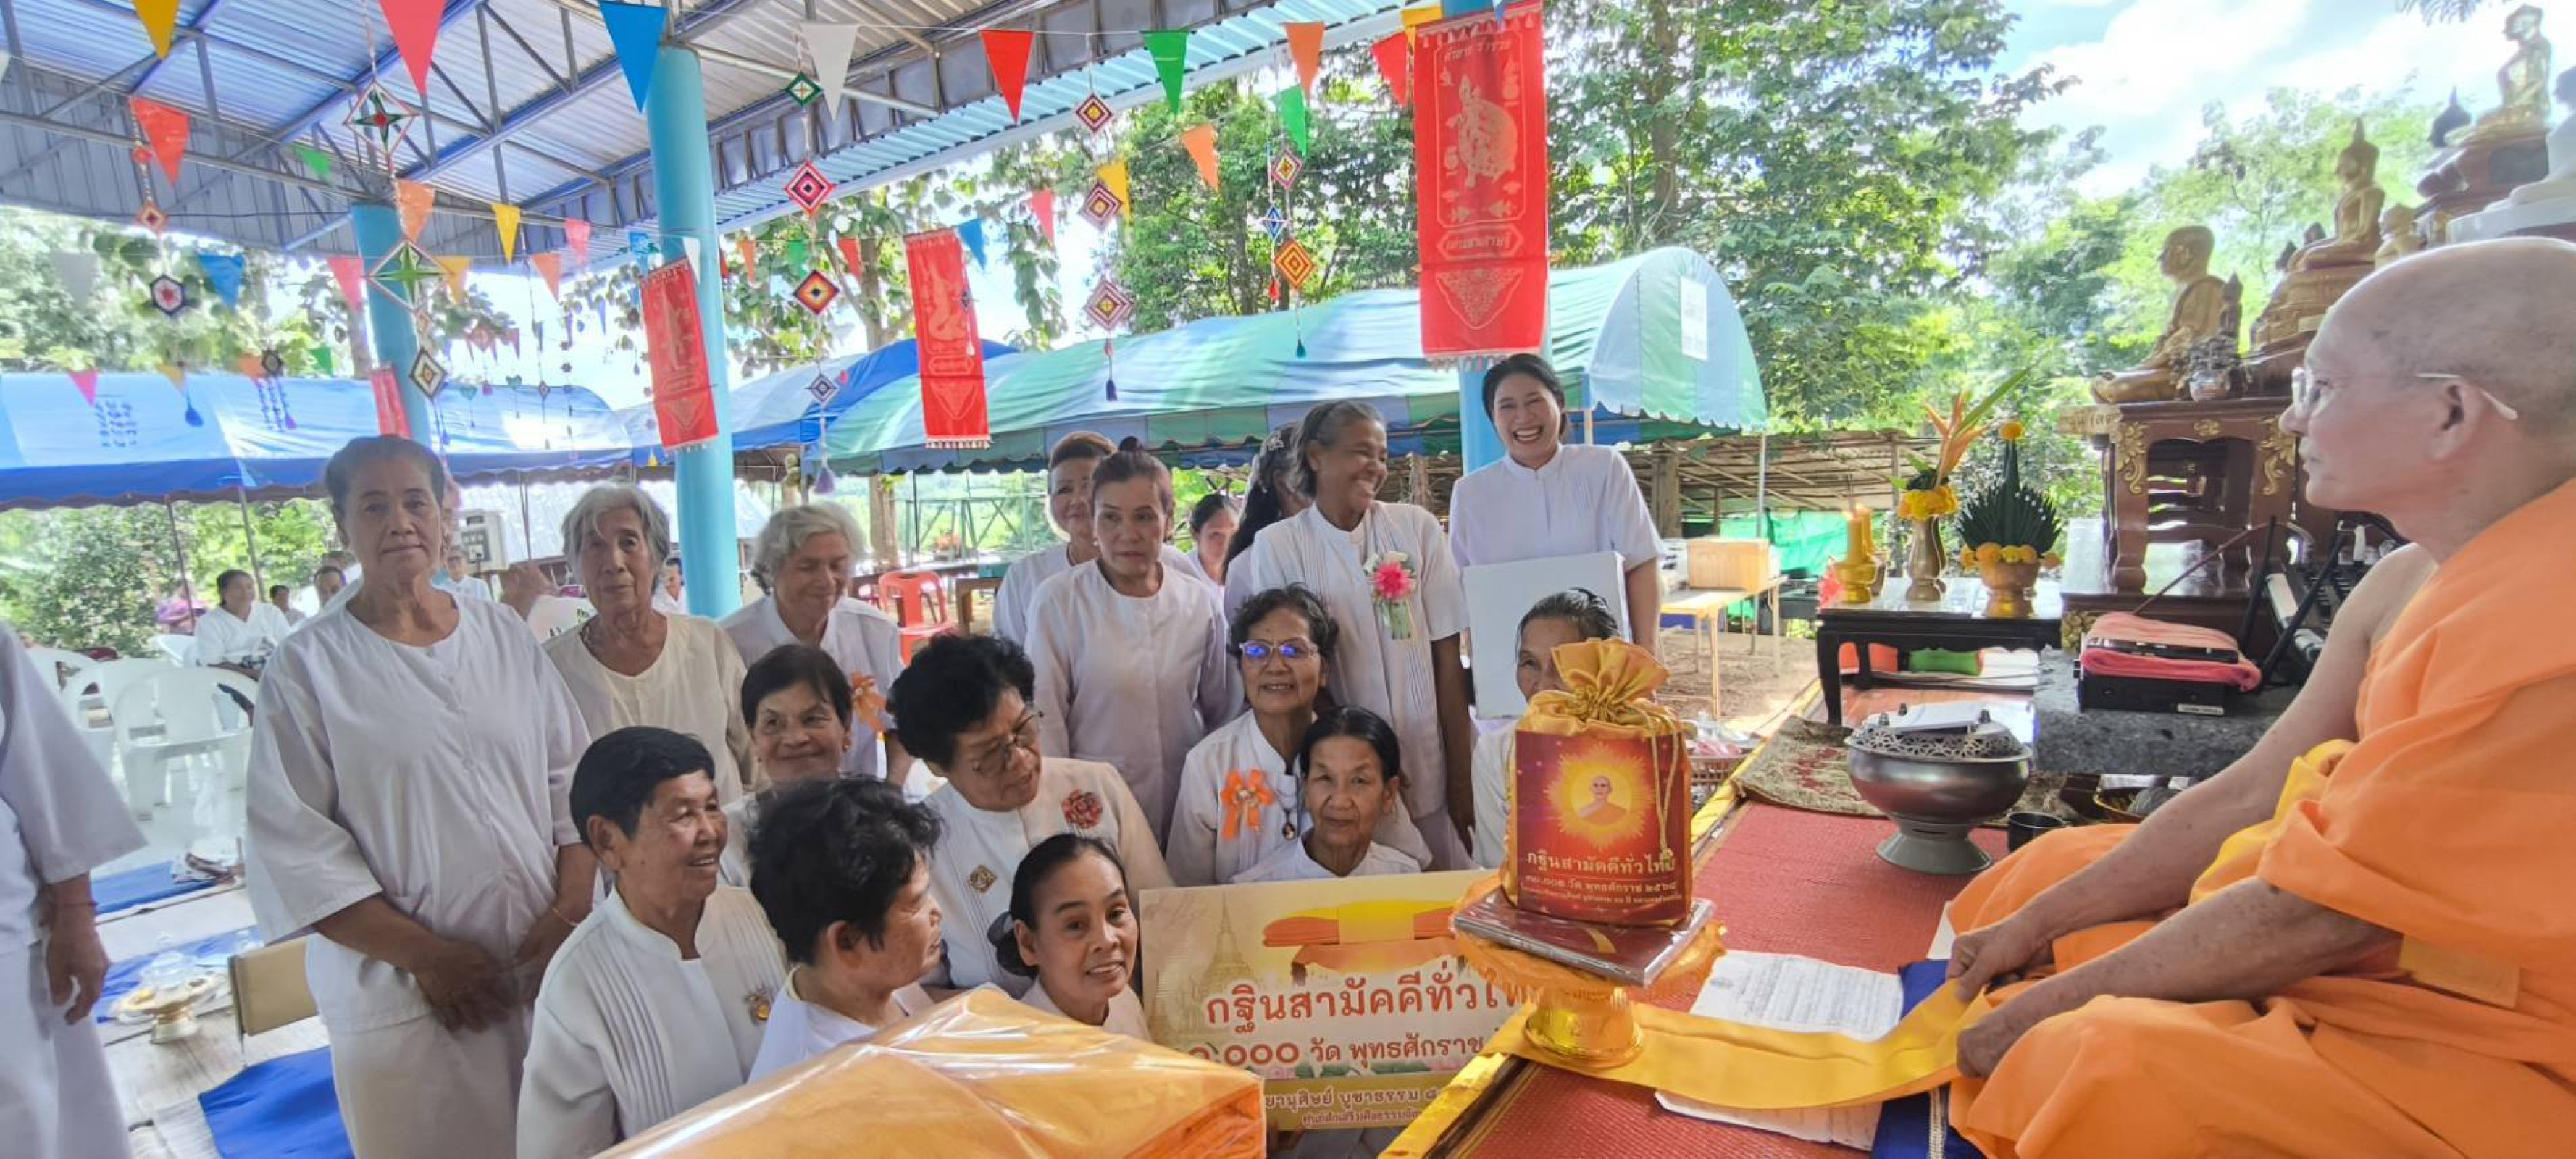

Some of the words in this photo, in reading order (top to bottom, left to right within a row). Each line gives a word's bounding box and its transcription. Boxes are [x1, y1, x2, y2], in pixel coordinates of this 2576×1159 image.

[1310, 1037, 1342, 1063] วัด
[1349, 1032, 1484, 1070] พุทธศักราช
[1266, 1087, 1334, 1112] ยานุศิษย์
[1340, 1089, 1419, 1110] บูชาธรรม
